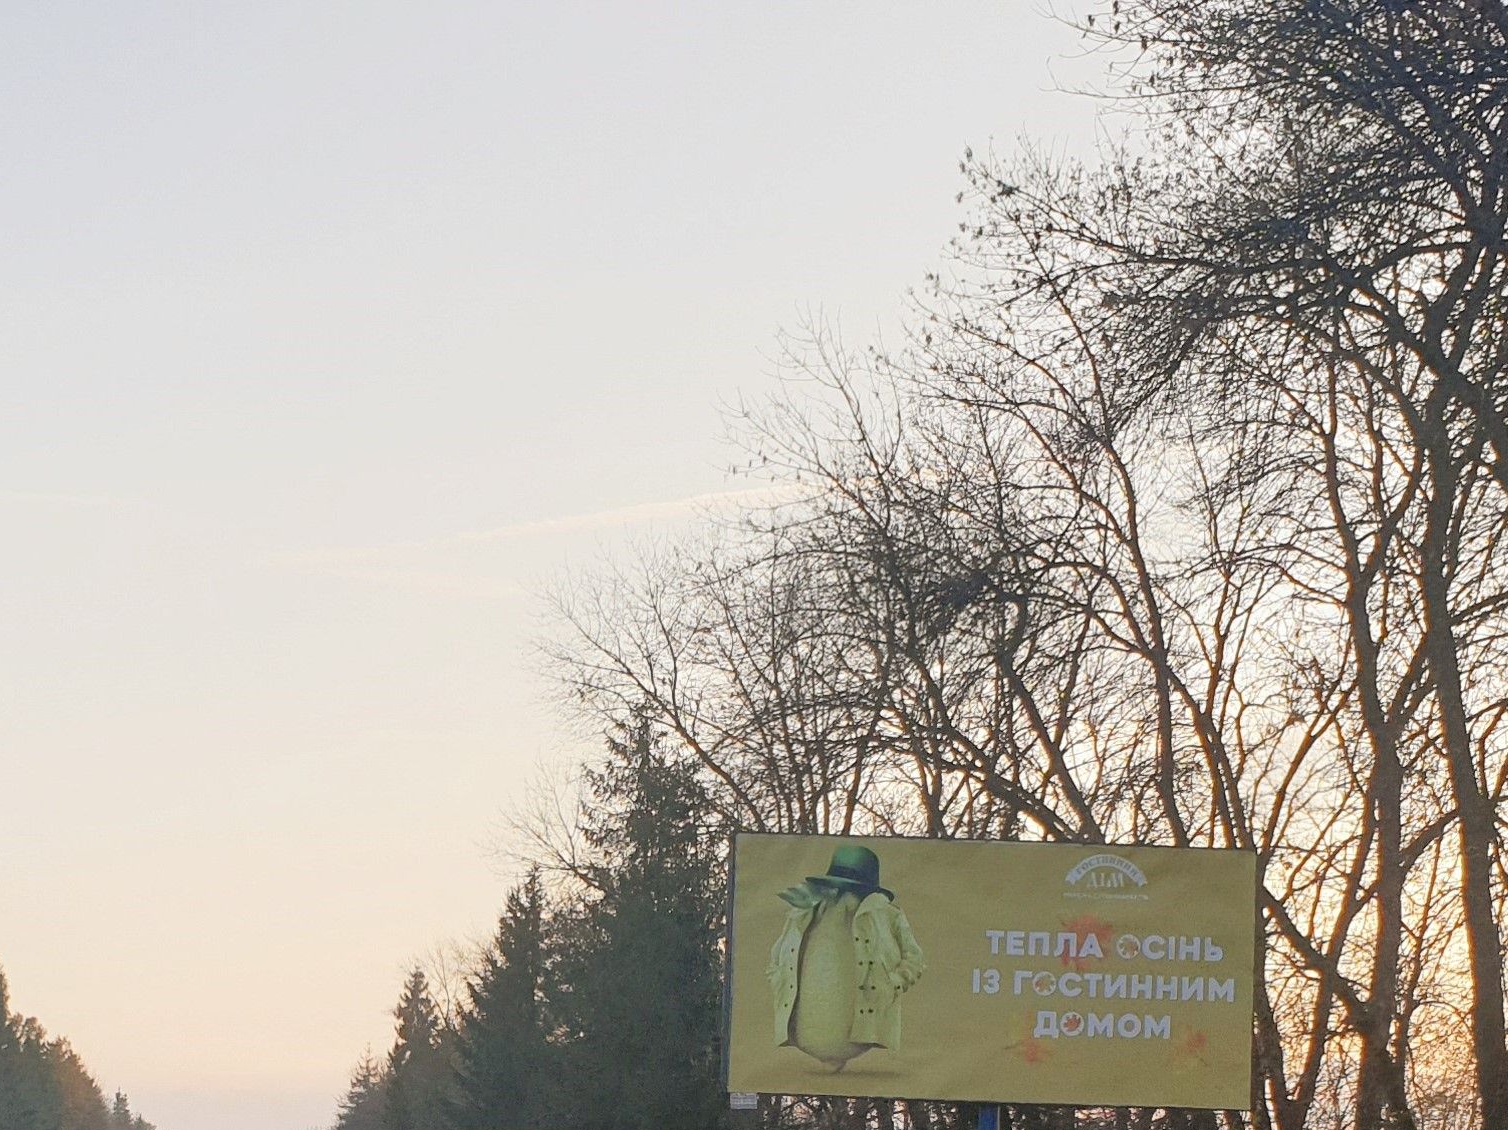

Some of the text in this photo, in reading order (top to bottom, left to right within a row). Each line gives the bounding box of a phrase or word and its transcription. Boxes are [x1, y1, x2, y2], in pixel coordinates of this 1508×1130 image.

[985, 930, 1224, 962] ТЕПЛА ОСІНЬ
[972, 968, 1235, 1003] ІЗ ГОСТИННИМ
[1033, 1010, 1172, 1040] ДОМОМ
